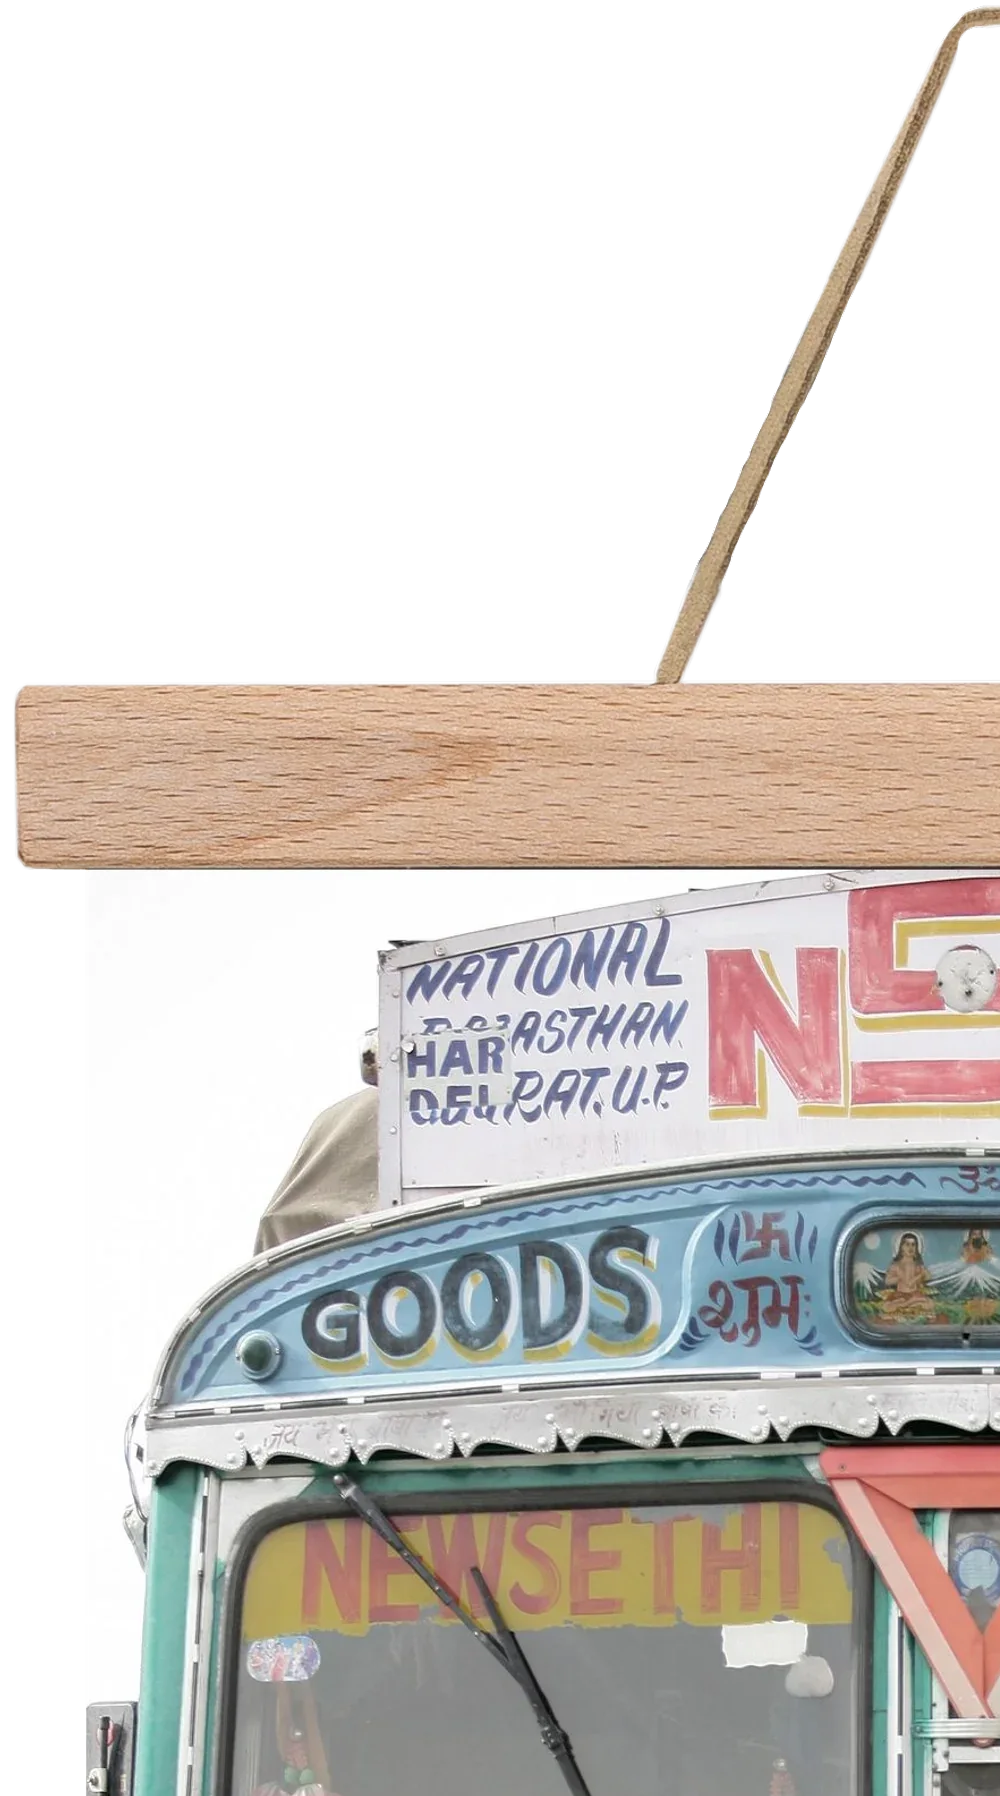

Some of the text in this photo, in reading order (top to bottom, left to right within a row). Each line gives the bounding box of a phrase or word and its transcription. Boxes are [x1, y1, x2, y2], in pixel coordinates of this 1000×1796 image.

[406, 917, 683, 1005] NATIONAL
[406, 1036, 507, 1078] HAR
[300, 1224, 661, 1373] GOODS
